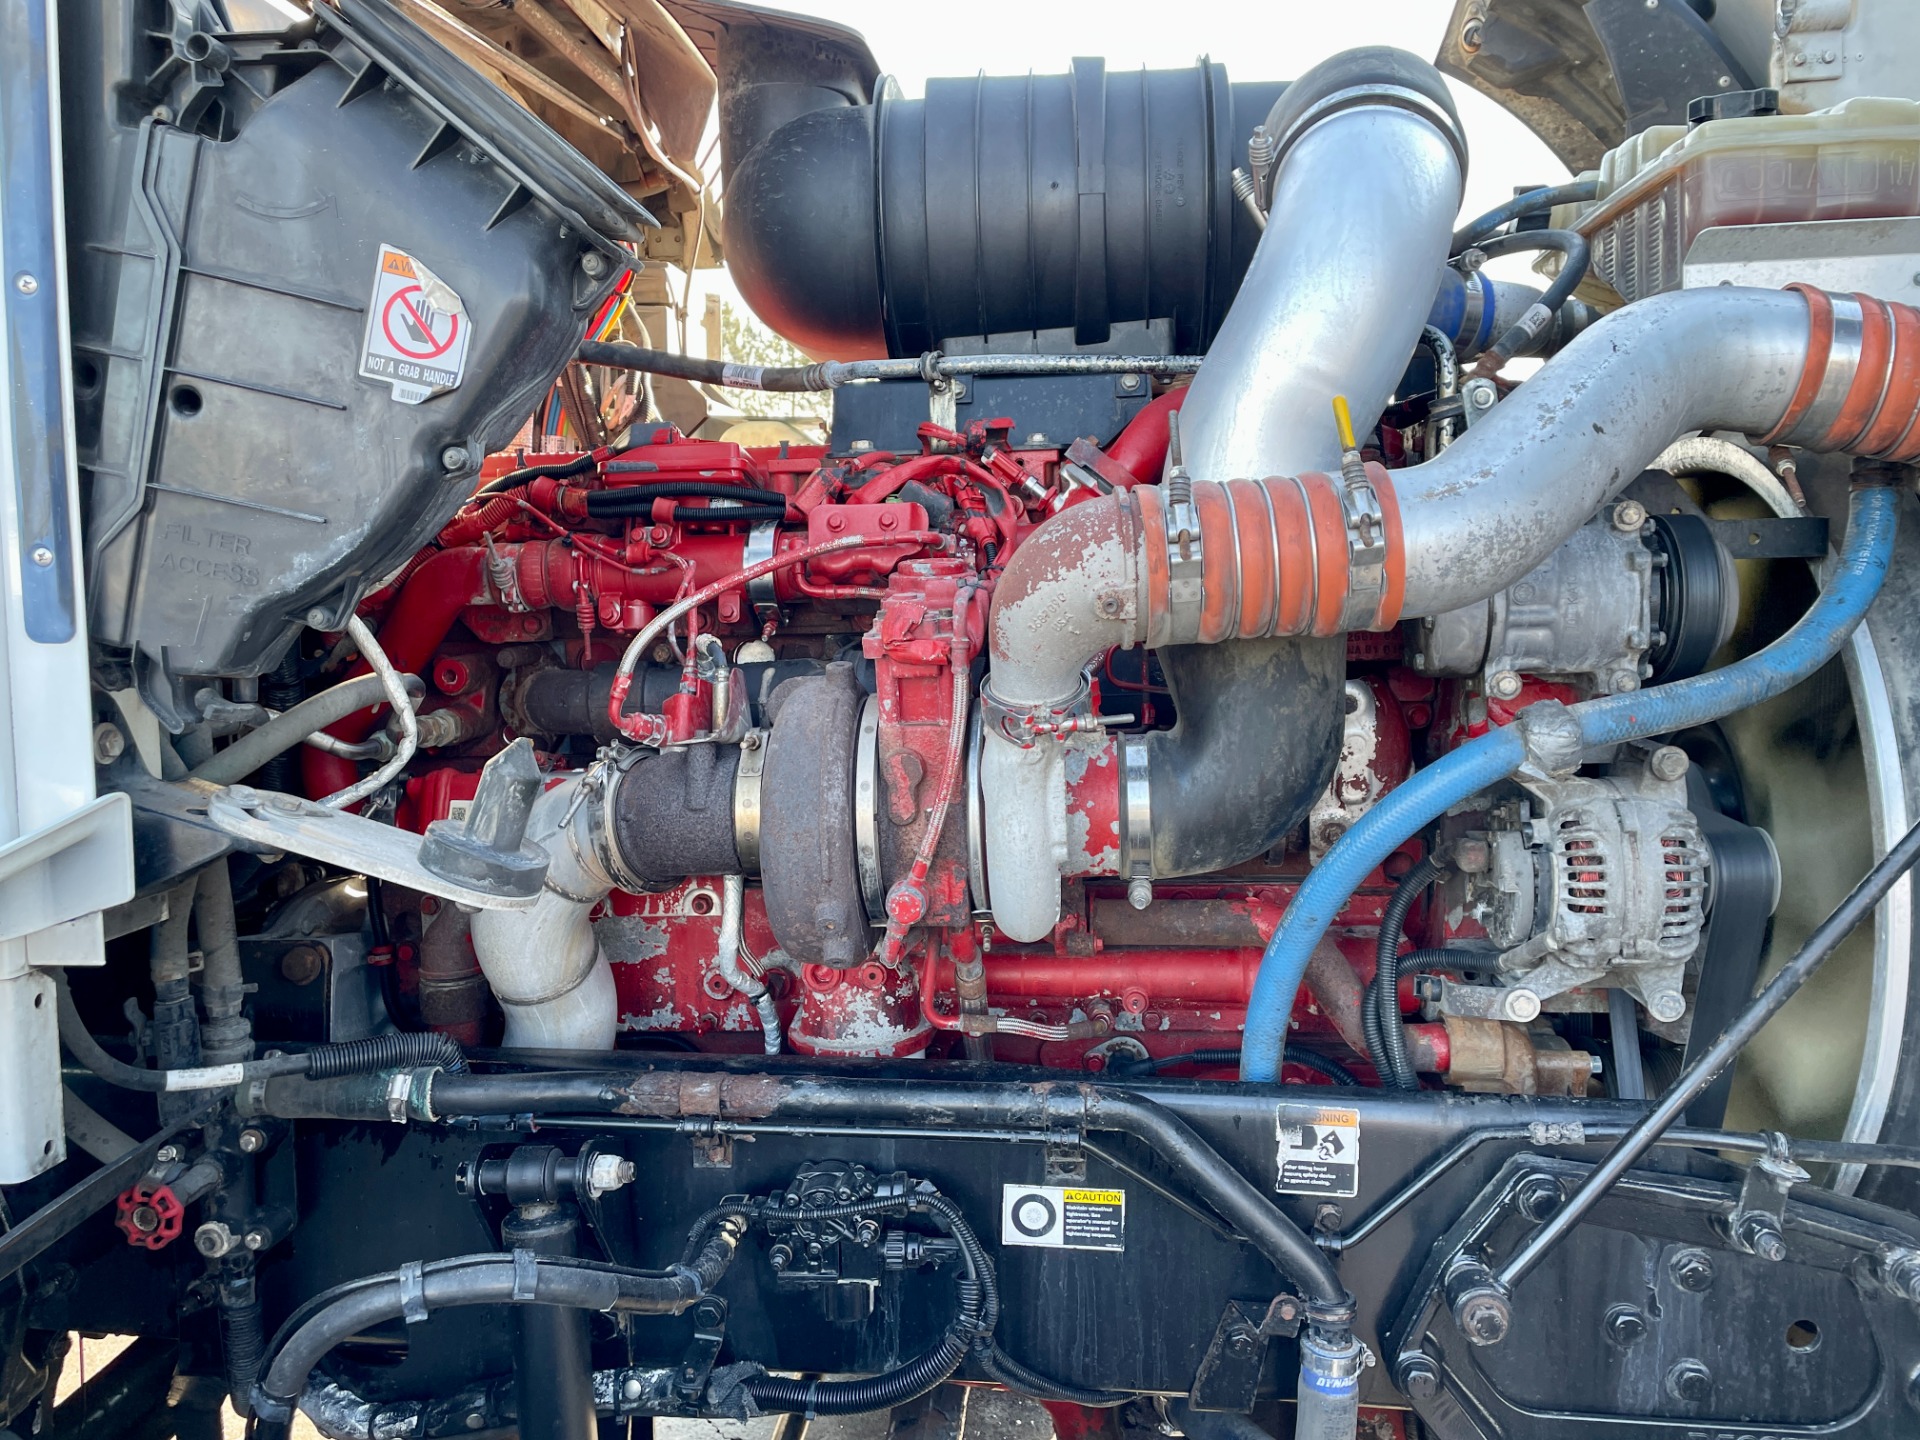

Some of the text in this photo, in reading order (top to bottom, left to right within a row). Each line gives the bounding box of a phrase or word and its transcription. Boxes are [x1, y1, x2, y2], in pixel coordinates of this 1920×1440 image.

[367, 356, 456, 387] NOT A GRAB HANDLE
[164, 523, 251, 556] FILTER
[160, 551, 260, 587] ACCESS
[1314, 1112, 1350, 1123] RNING
[1074, 1192, 1121, 1203] CAUTION
